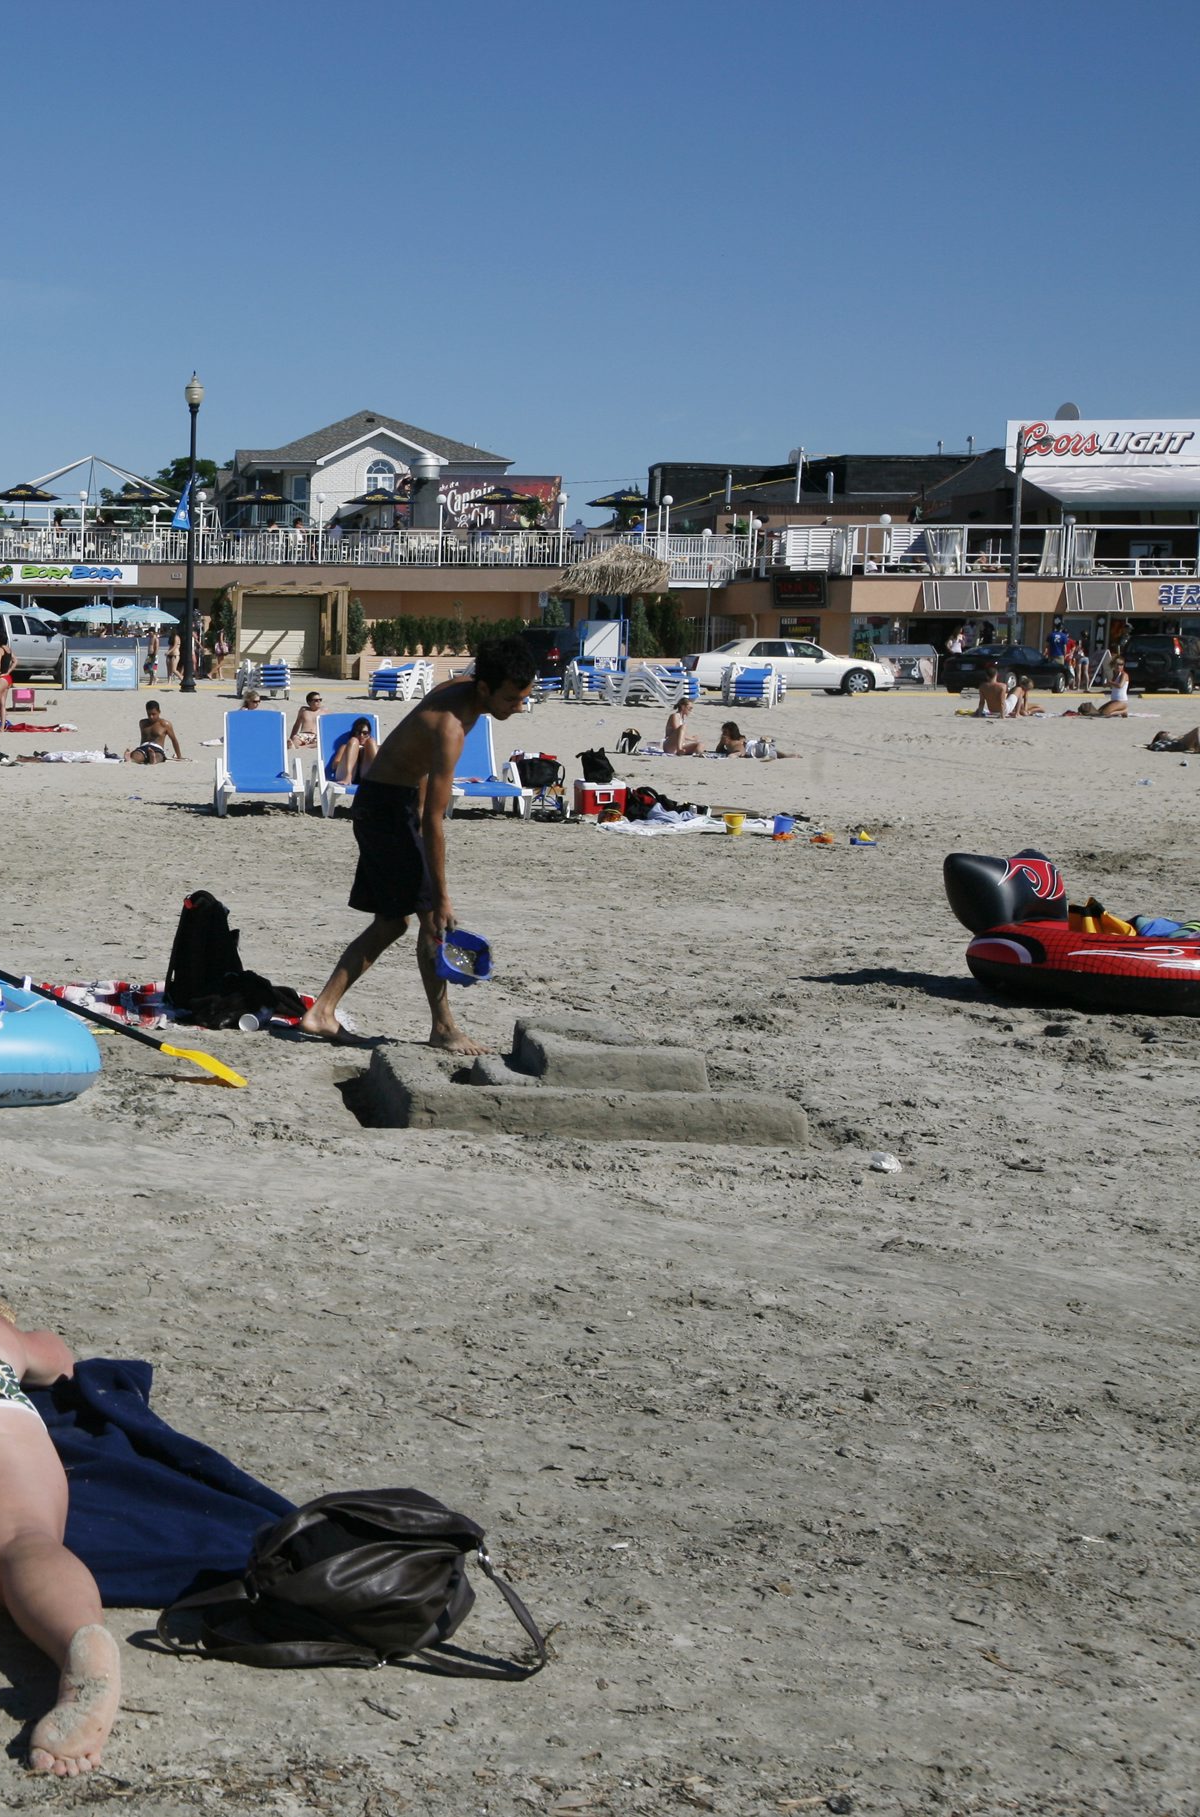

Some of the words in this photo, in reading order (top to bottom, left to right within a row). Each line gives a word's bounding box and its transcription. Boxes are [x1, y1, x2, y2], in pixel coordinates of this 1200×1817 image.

[1019, 422, 1100, 457] Coors
[1100, 431, 1195, 455] LIGHT
[20, 565, 72, 580] BORA
[71, 565, 123, 580] BORA
[1158, 595, 1200, 606] BEA
